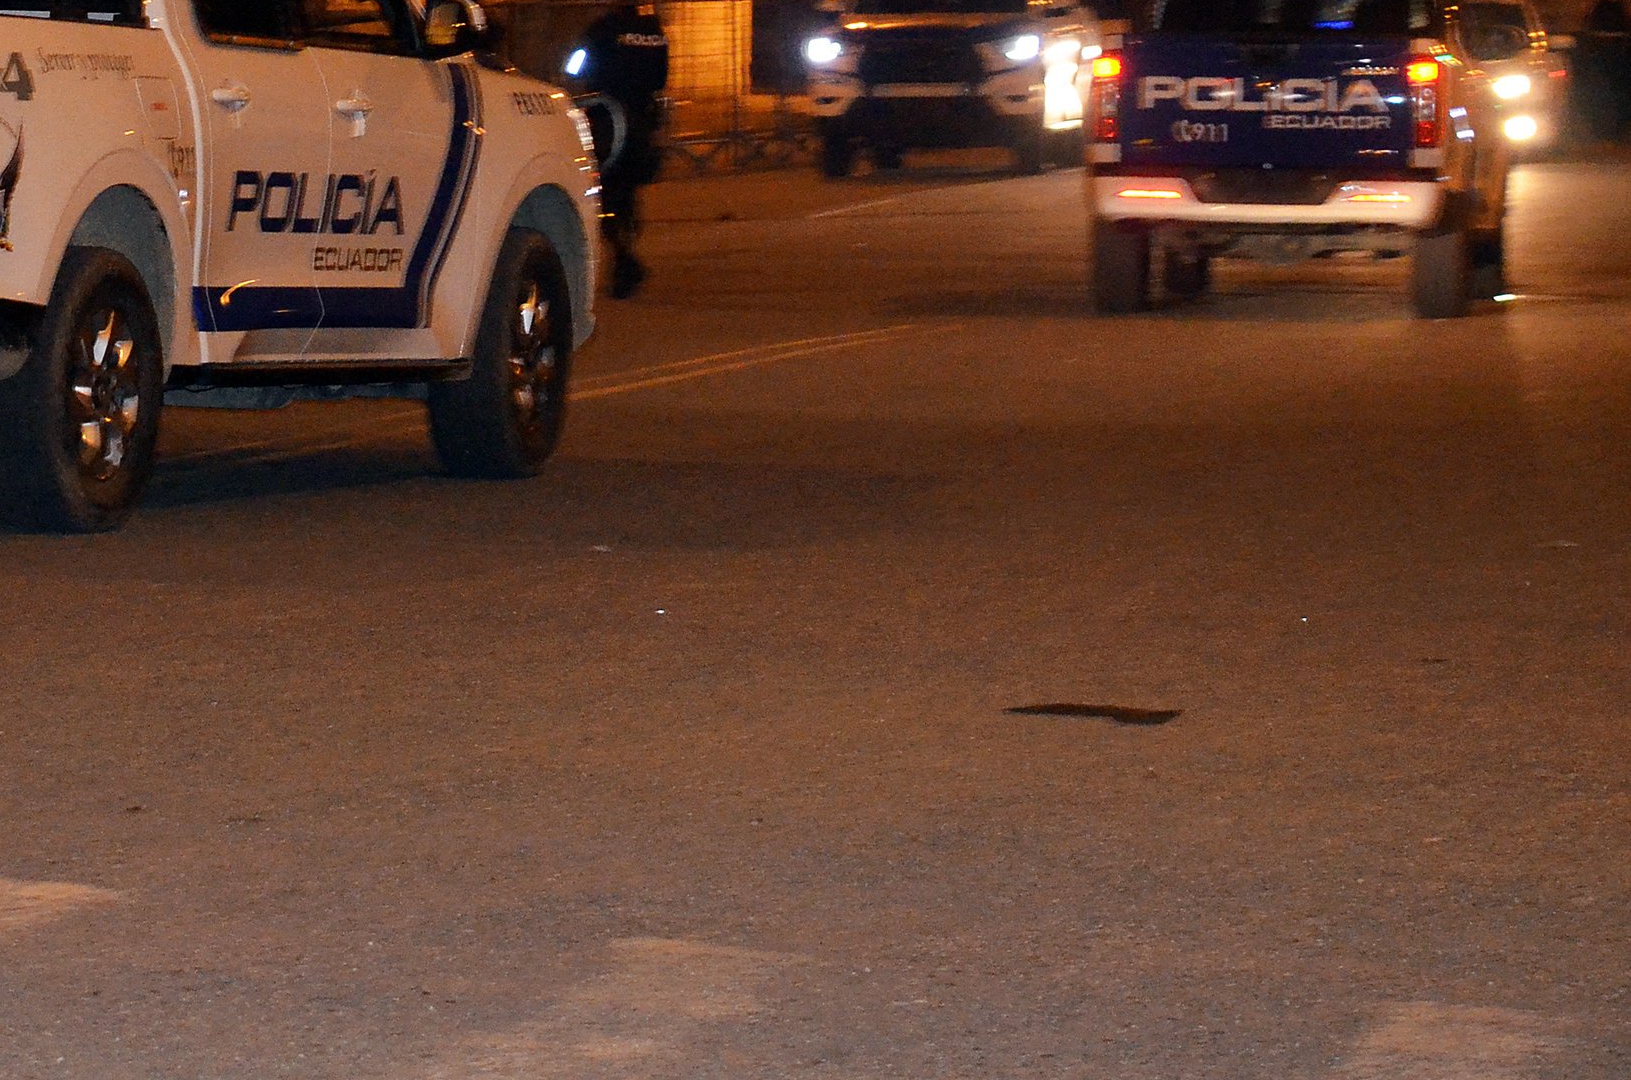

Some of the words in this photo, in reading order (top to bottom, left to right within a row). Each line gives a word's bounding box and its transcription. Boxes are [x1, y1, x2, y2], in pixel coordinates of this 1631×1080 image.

[1264, 115, 1390, 130] ECUADOR
[225, 169, 404, 235] POLICÍA
[314, 247, 402, 271] ECUADOR
